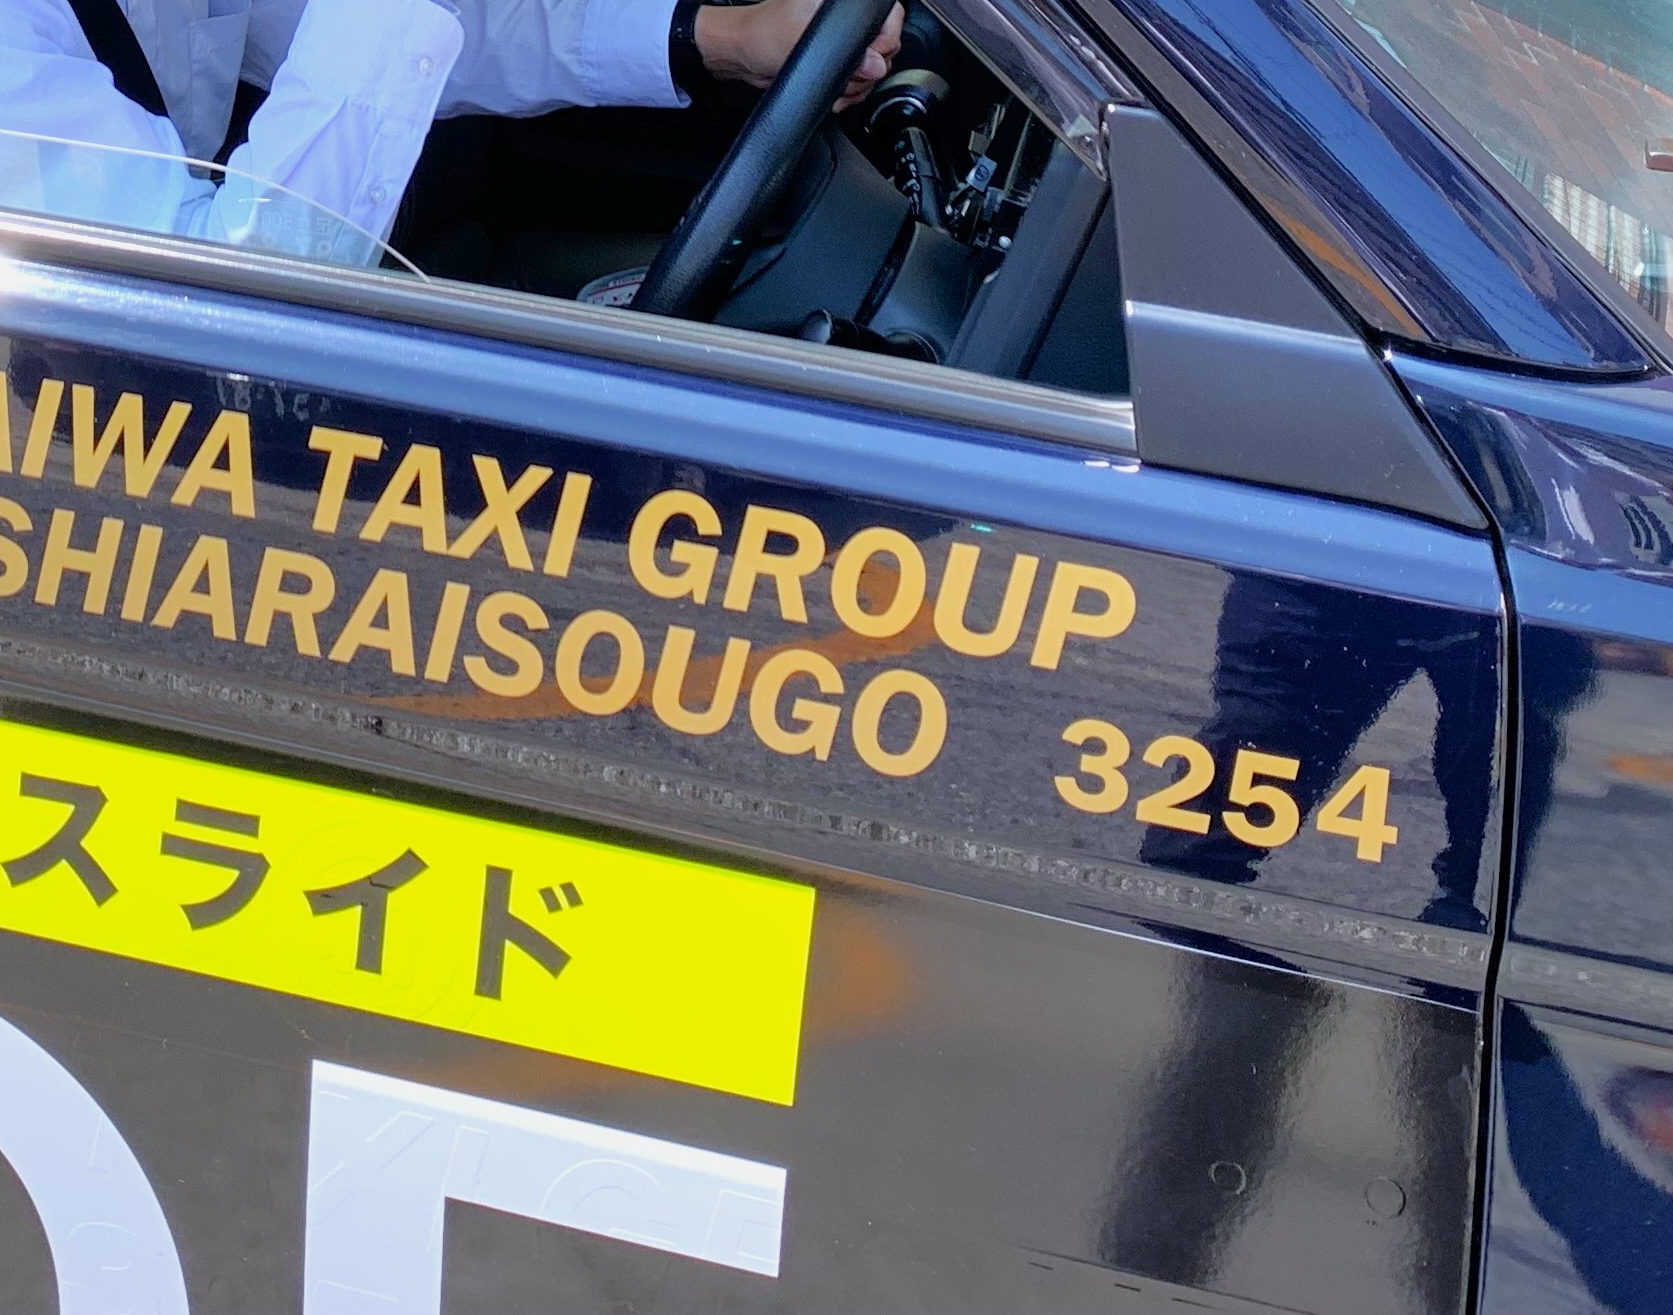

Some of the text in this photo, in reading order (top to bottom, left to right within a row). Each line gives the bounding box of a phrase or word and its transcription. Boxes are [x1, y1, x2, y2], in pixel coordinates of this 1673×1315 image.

[309, 425, 593, 578] TAXI
[627, 489, 1136, 671] GROUP
[1055, 719, 1399, 863] 3254
